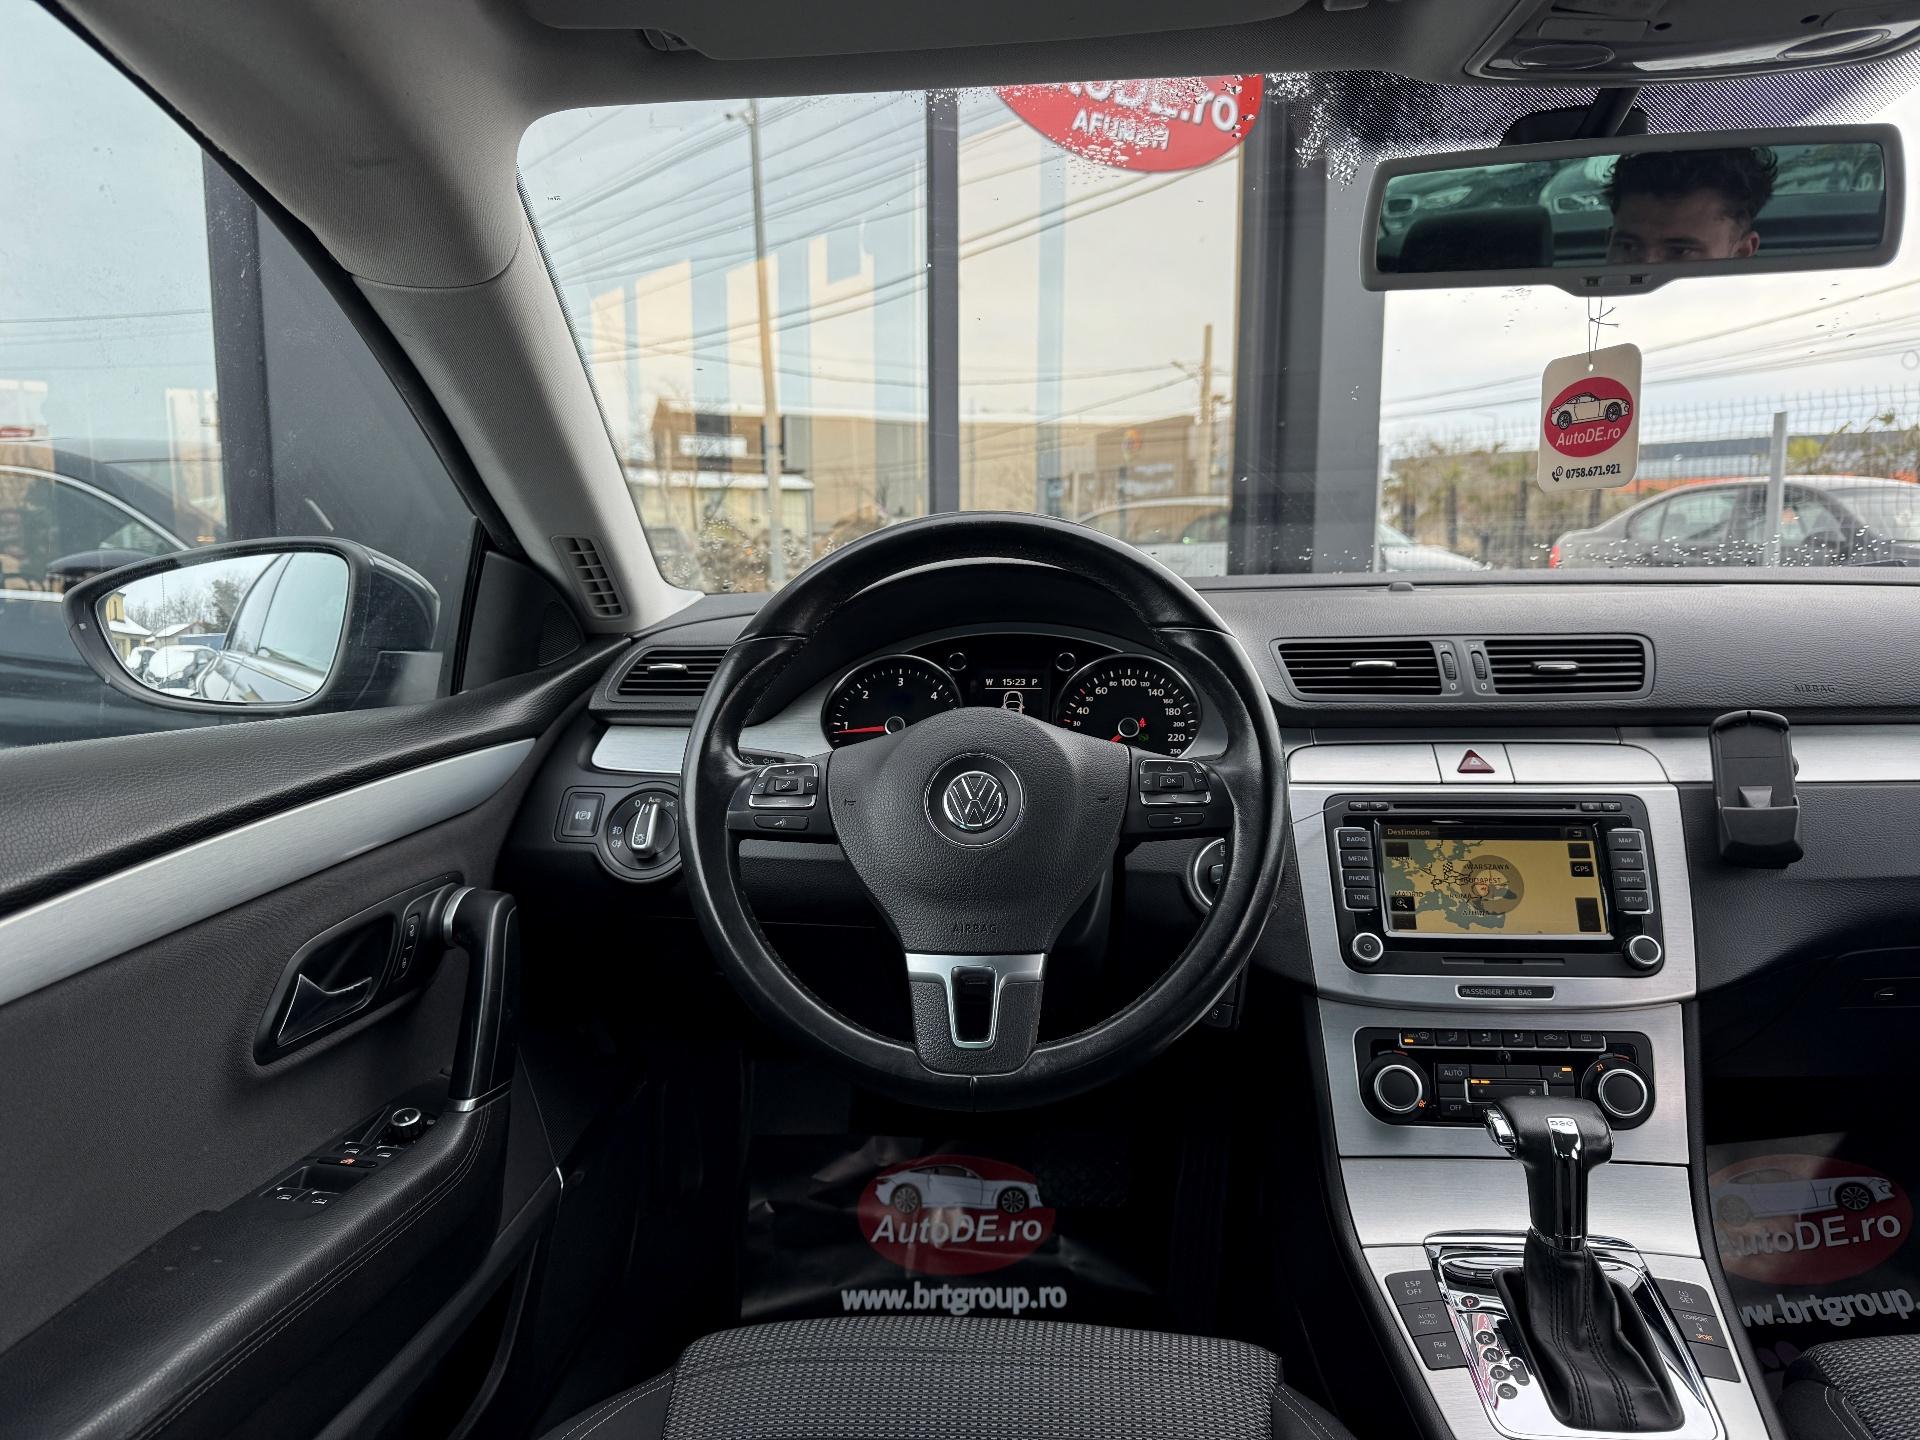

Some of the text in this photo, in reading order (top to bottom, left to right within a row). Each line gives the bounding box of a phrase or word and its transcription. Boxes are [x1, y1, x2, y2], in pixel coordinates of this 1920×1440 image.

[1556, 426, 1621, 447] AutoDE.ro
[1565, 463, 1621, 480] 0758.671.921
[897, 677, 904, 687] 3
[1002, 678, 1026, 686] 15:23
[1031, 678, 1038, 686] P
[1121, 678, 1137, 687] 100
[862, 690, 869, 700] 2
[930, 690, 938, 700] 4
[1095, 687, 1108, 696] 60
[1148, 688, 1164, 698] 140
[1076, 707, 1090, 715] 40
[1165, 707, 1181, 716] 180
[1167, 733, 1186, 742] 220
[1387, 828, 1430, 837] Destination
[1574, 865, 1590, 873] GPS
[1348, 874, 1370, 882] PHONE
[1624, 896, 1643, 904] SETUP
[1462, 988, 1501, 996] PASSENGER
[1444, 1069, 1463, 1077] AUTO
[870, 1213, 1043, 1244] AutoDE.ro
[840, 1280, 1068, 1315] www.brtgroup.ro
[1482, 1335, 1490, 1344] R
[1487, 1351, 1498, 1361] N
[1494, 1369, 1505, 1379] D
[1502, 1387, 1511, 1397] S
